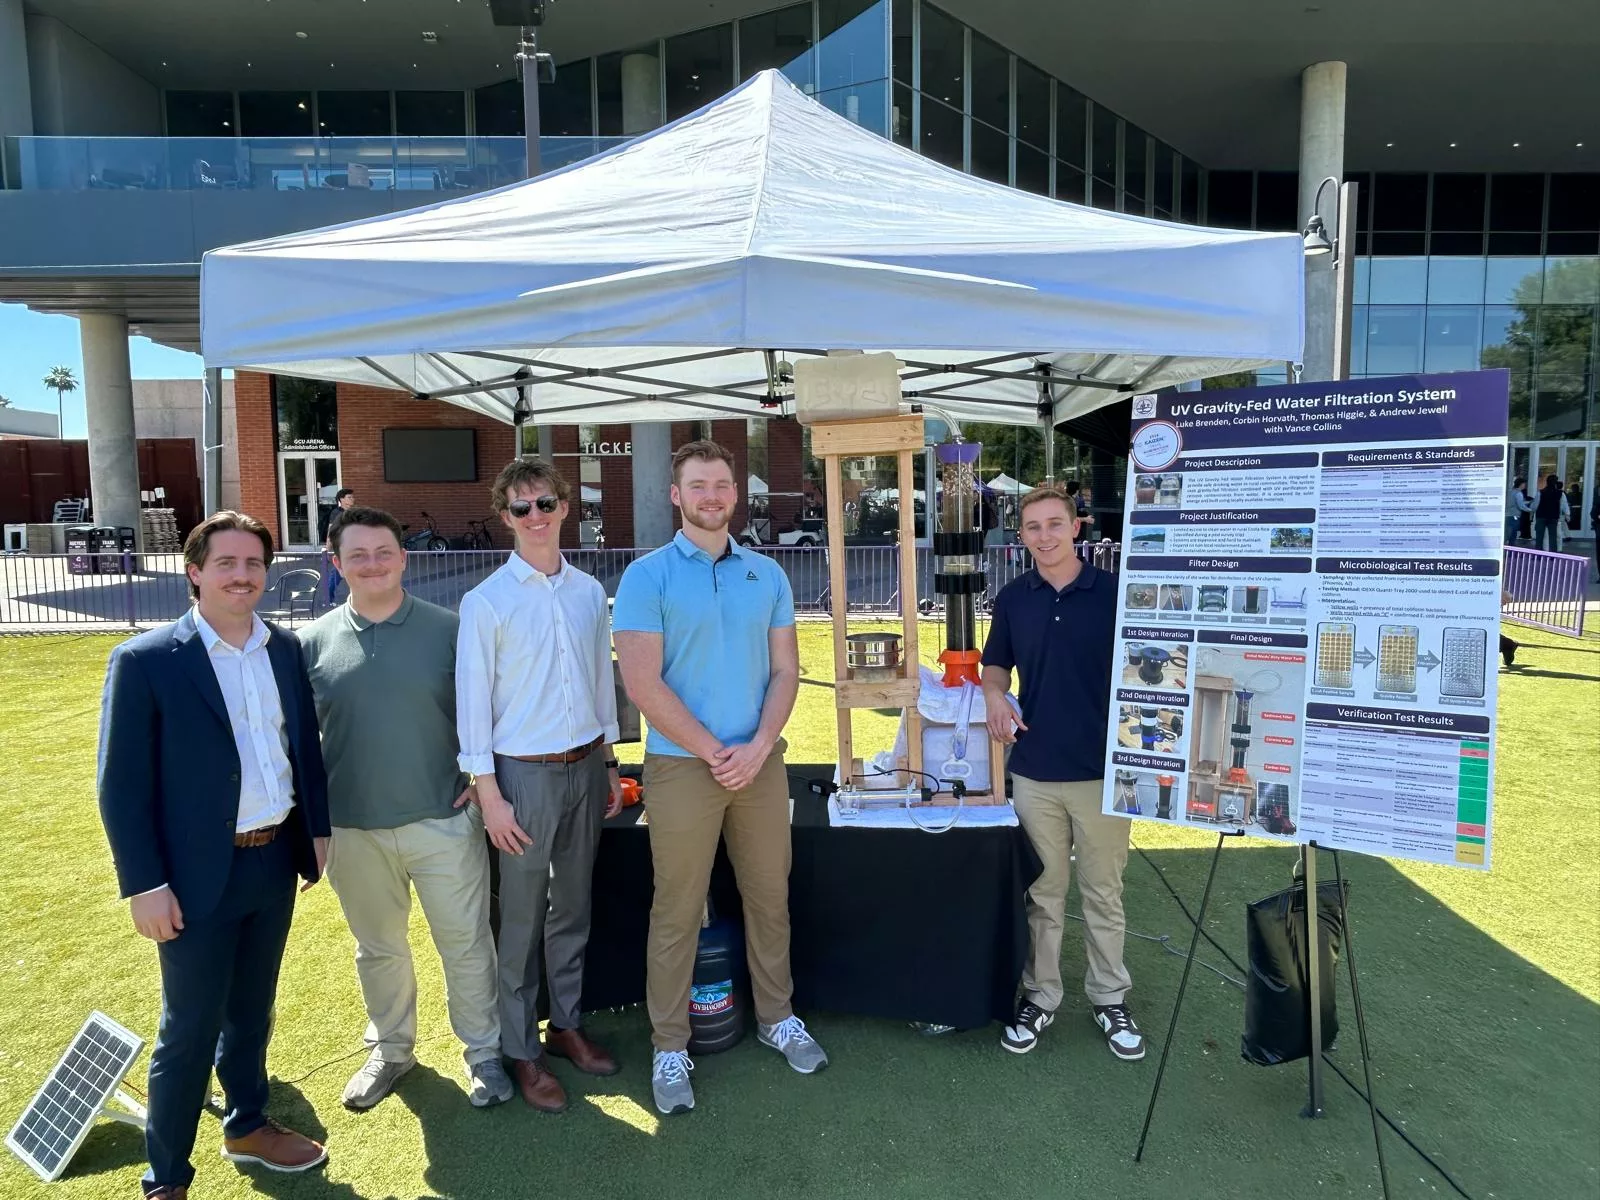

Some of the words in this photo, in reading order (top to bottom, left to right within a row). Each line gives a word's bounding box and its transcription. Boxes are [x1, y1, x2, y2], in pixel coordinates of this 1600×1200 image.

[1171, 405, 1190, 416] UV
[1194, 400, 1271, 416] Gravity-Fed
[1276, 397, 1320, 409] Water
[1324, 392, 1393, 406] Filtration
[1398, 389, 1456, 404] System
[1196, 418, 1231, 427] Brenden,
[1233, 416, 1260, 425] Corbin
[1262, 414, 1298, 423] Horvath,
[1301, 412, 1334, 421] Thomas
[1336, 410, 1367, 420] Higgie,
[1379, 408, 1416, 416] Andrew
[1418, 405, 1448, 415] Jewell
[1313, 422, 1342, 431] Collins
[584, 442, 632, 454] TICKE
[1348, 452, 1412, 463] Requirements
[1415, 451, 1422, 460] &
[1426, 448, 1475, 460] Standards
[1185, 459, 1213, 468] Project
[1214, 458, 1260, 467] Description
[1180, 512, 1208, 521] Project
[1212, 560, 1239, 568] Design
[1340, 561, 1410, 571] Microbiological
[1414, 562, 1434, 570] Test
[1437, 562, 1472, 571] Results
[1138, 629, 1159, 638] Design
[1160, 630, 1188, 638] Iteration
[1248, 635, 1272, 644] Design
[1134, 692, 1155, 701] Design
[1156, 694, 1185, 702] Iteration
[1338, 708, 1392, 720] Verification
[1394, 713, 1415, 722] Test
[1418, 715, 1454, 726] Results
[1129, 756, 1150, 765] Design
[1152, 757, 1180, 768] Iteration
[692, 1000, 727, 1010] ARROWHEAD
